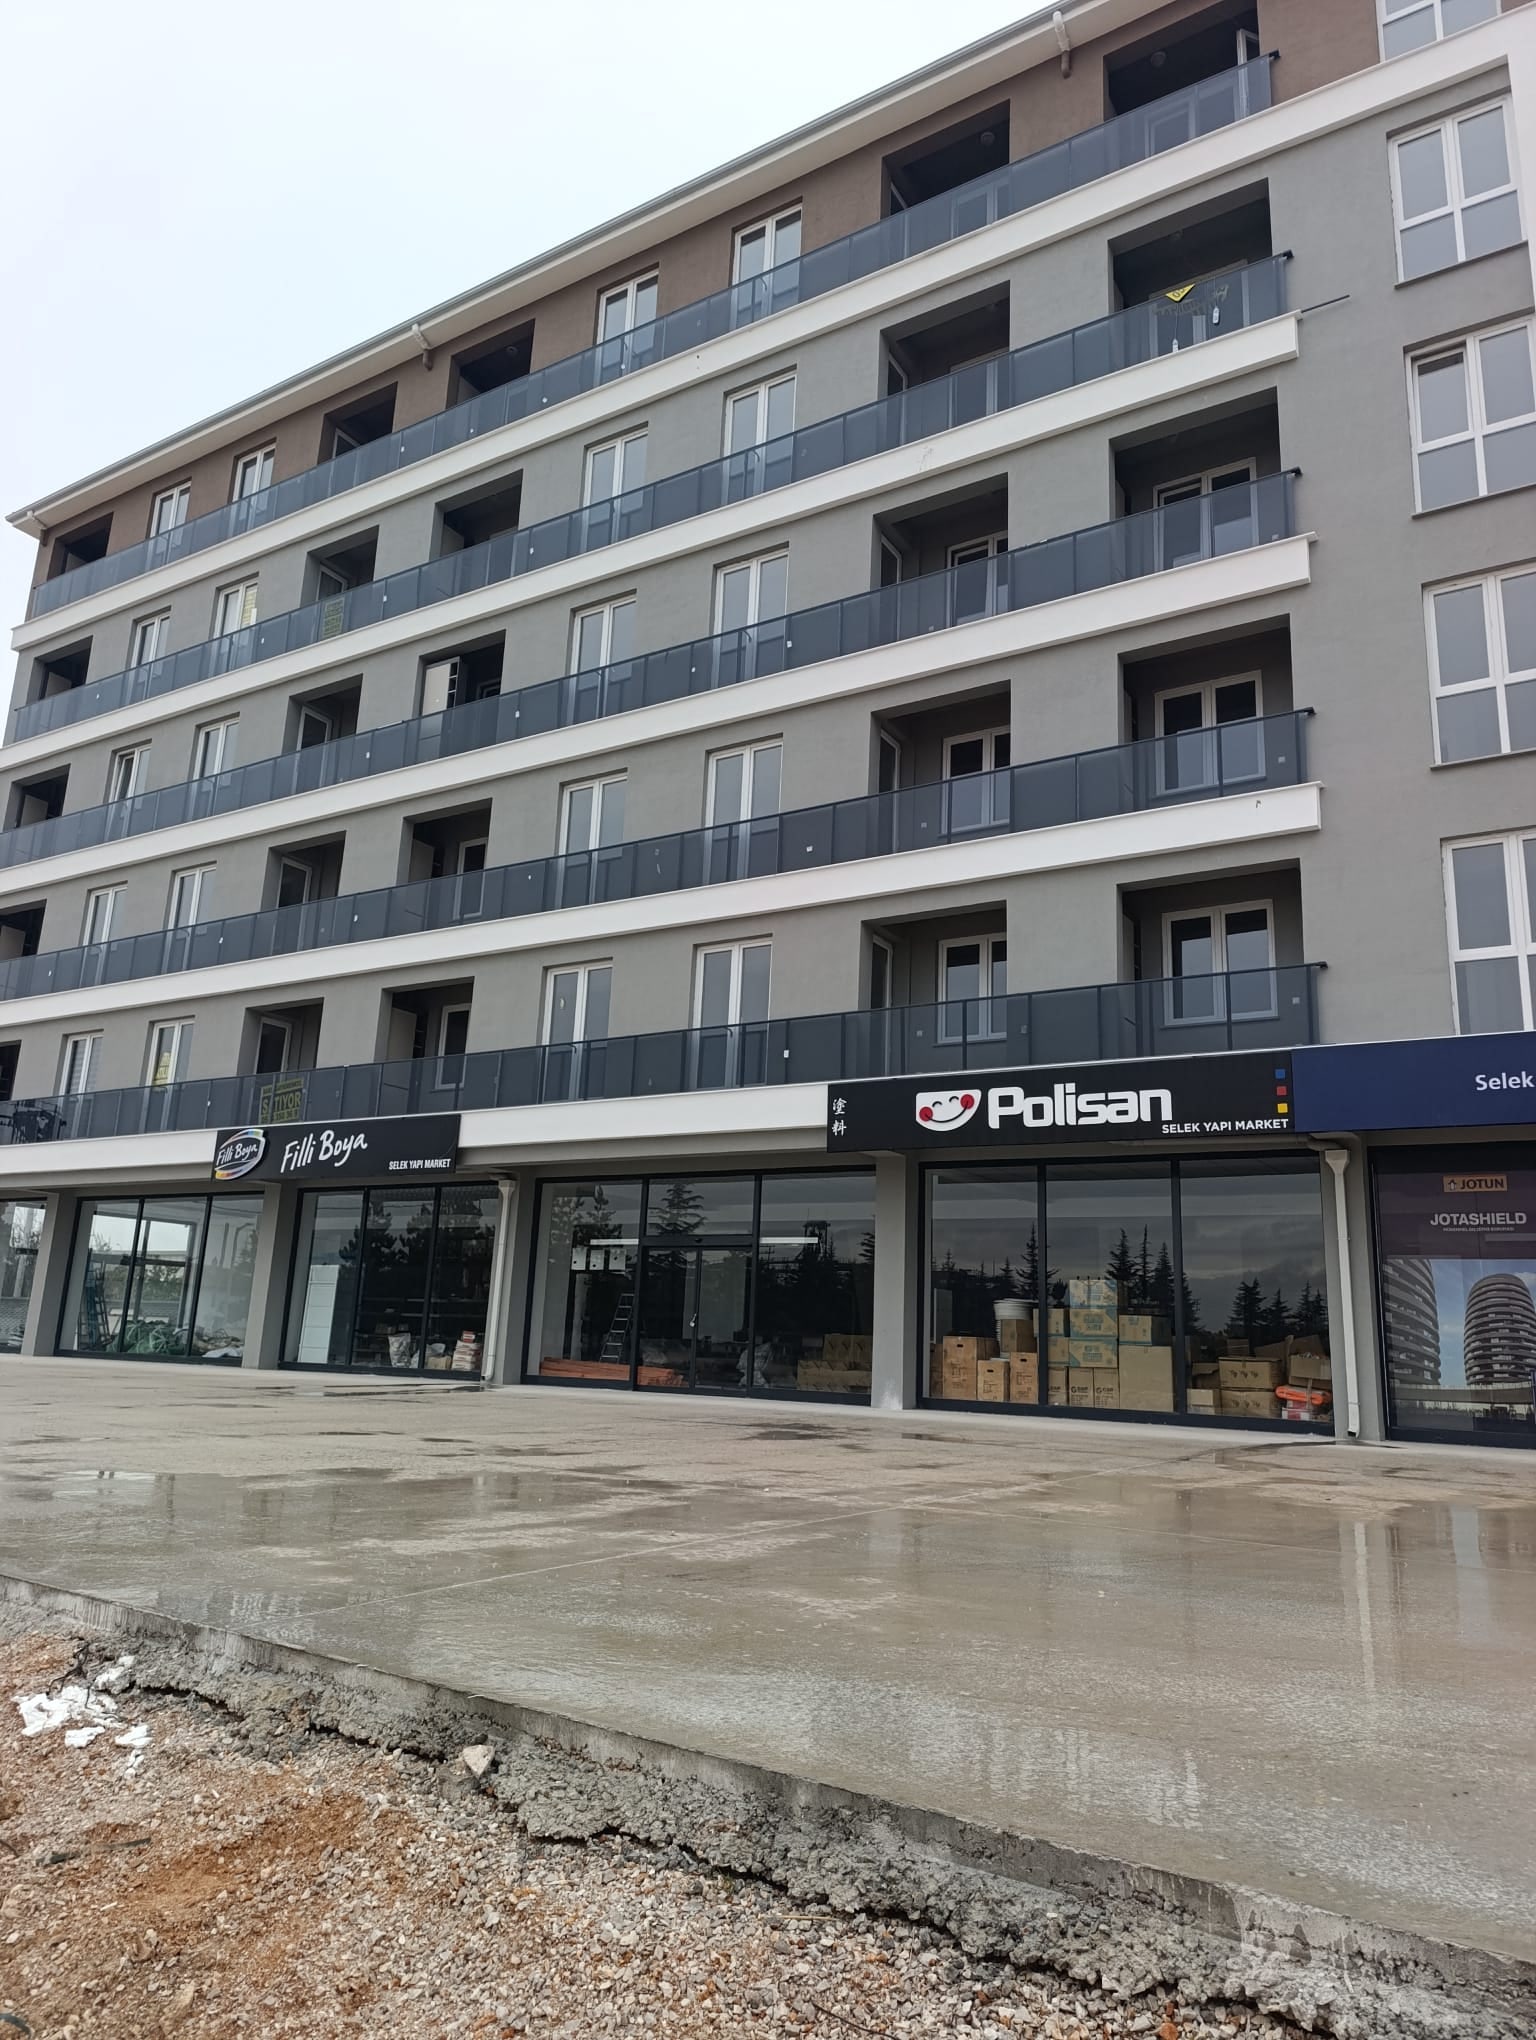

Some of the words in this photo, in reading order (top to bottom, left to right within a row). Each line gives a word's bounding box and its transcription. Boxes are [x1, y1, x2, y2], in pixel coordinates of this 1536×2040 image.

[1475, 1071, 1535, 1091] Selek
[262, 1091, 301, 1114] STIYOR
[987, 1082, 1173, 1129] Polisan
[1161, 1122, 1201, 1134] SELEK
[1203, 1121, 1232, 1132] YAPI
[1235, 1118, 1289, 1131] MARKET
[216, 1145, 235, 1166] Filli
[234, 1143, 258, 1161] Boya
[280, 1132, 317, 1174] Filli
[318, 1129, 369, 1168] Boya
[388, 1160, 408, 1171] SELEK
[409, 1159, 424, 1169] YAPI
[424, 1158, 452, 1169] MARKET
[1460, 1178, 1504, 1190] JOTUN
[1430, 1212, 1527, 1226] JOTASHIELD
